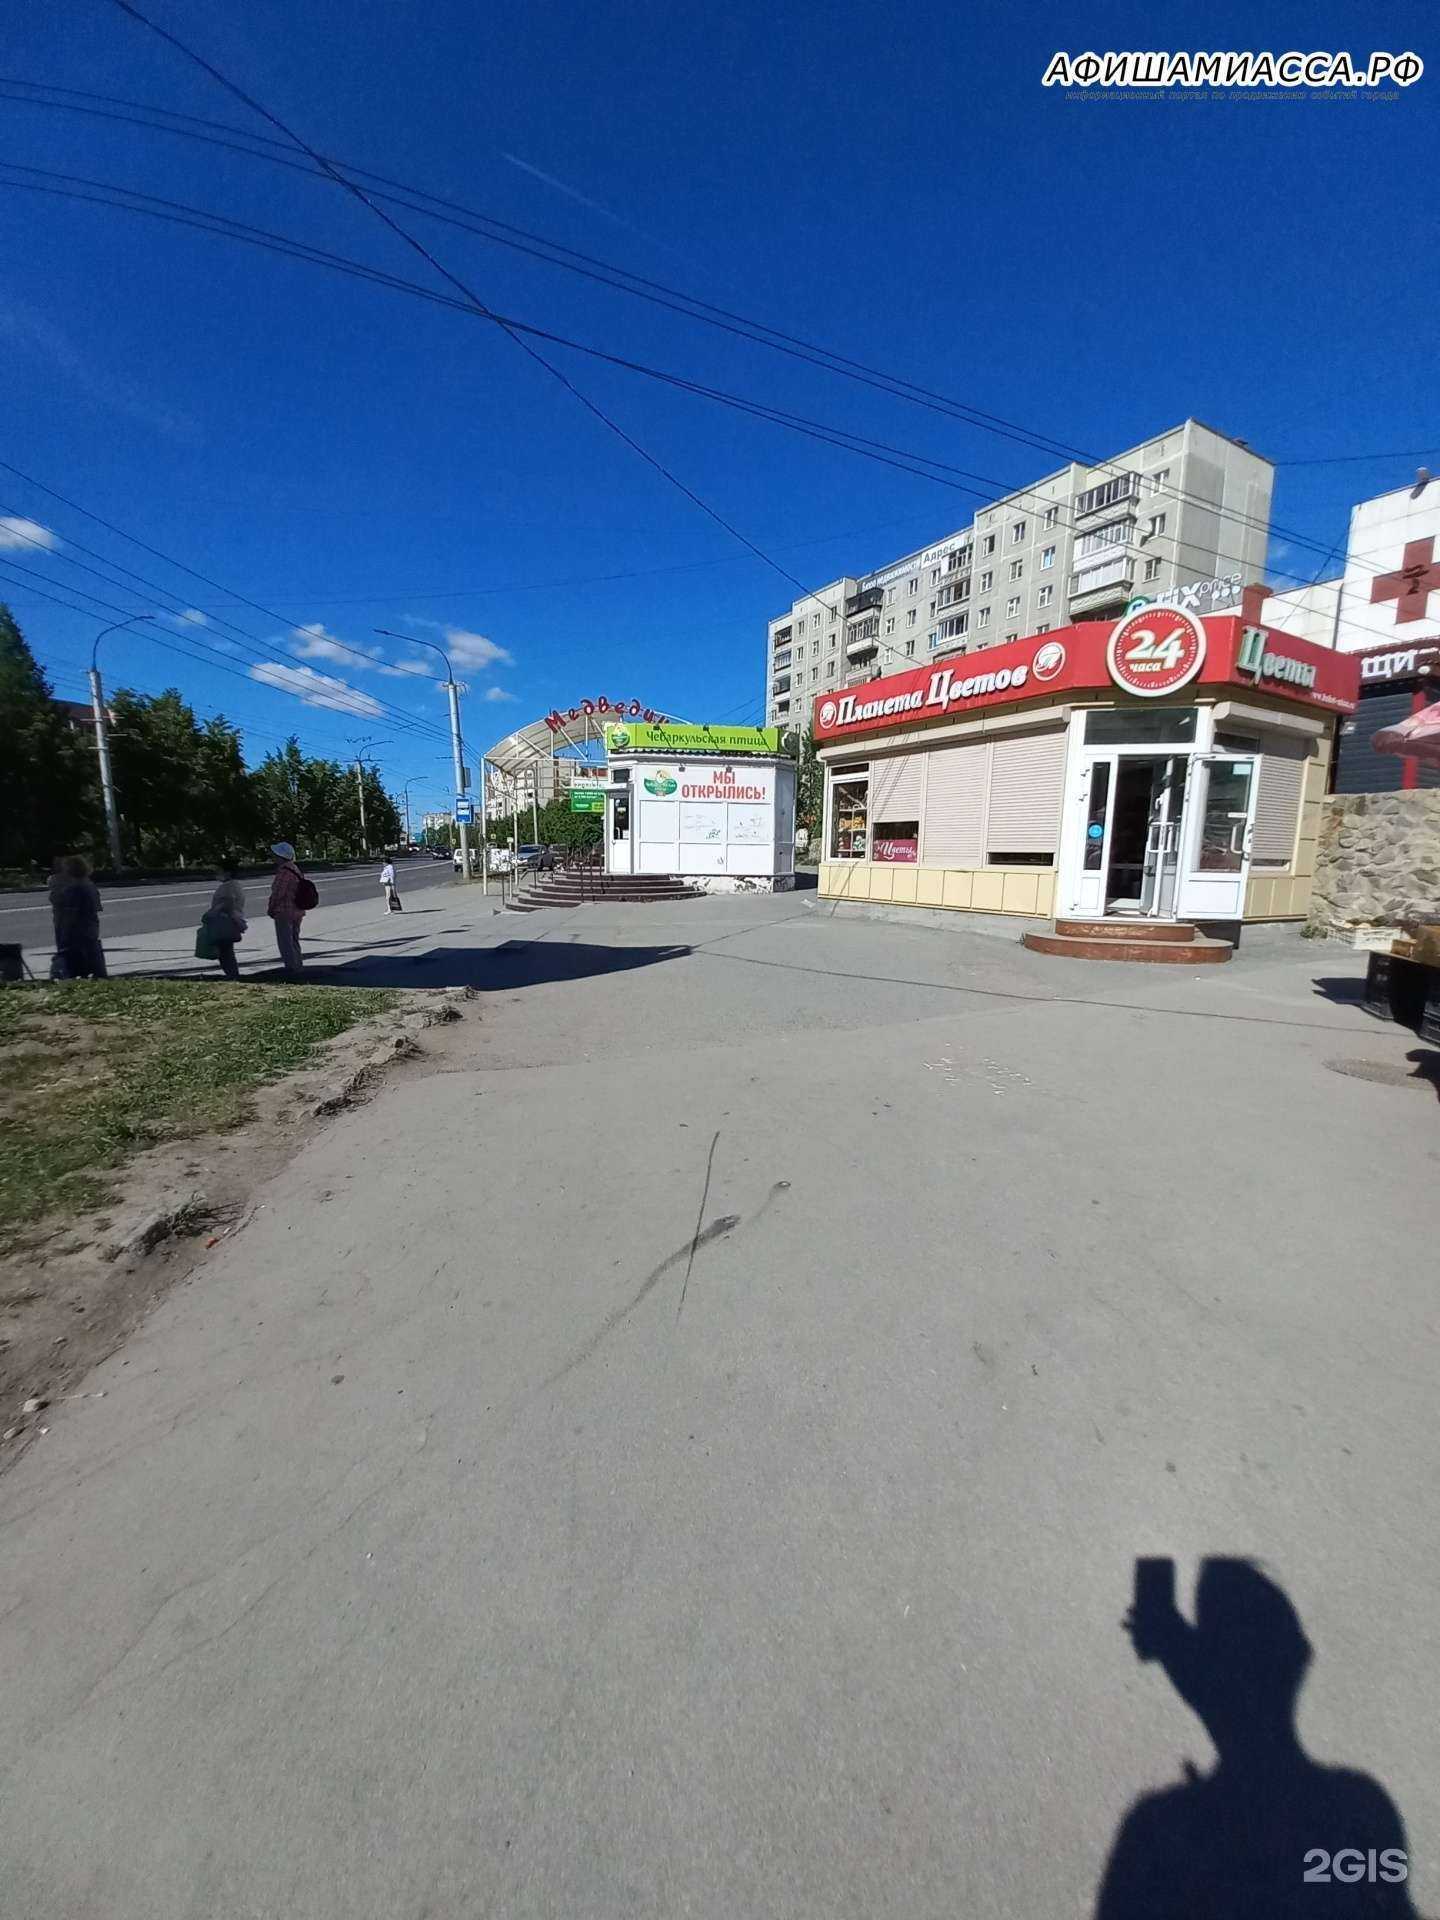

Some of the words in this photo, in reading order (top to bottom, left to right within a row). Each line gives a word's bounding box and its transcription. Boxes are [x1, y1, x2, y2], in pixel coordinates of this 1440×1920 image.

[923, 543, 955, 564] Адрес
[1125, 627, 1186, 670] 24
[1236, 625, 1317, 688] Цветы
[1129, 662, 1162, 673] часа
[835, 688, 925, 726] Планета
[925, 664, 1029, 711] Цветов
[646, 731, 726, 747] Чебаркульская
[729, 735, 766, 746] птица
[713, 771, 736, 785] МЫ
[681, 785, 766, 800] ОТКРЫЛИСЬ!
[880, 841, 913, 860] Цветы
